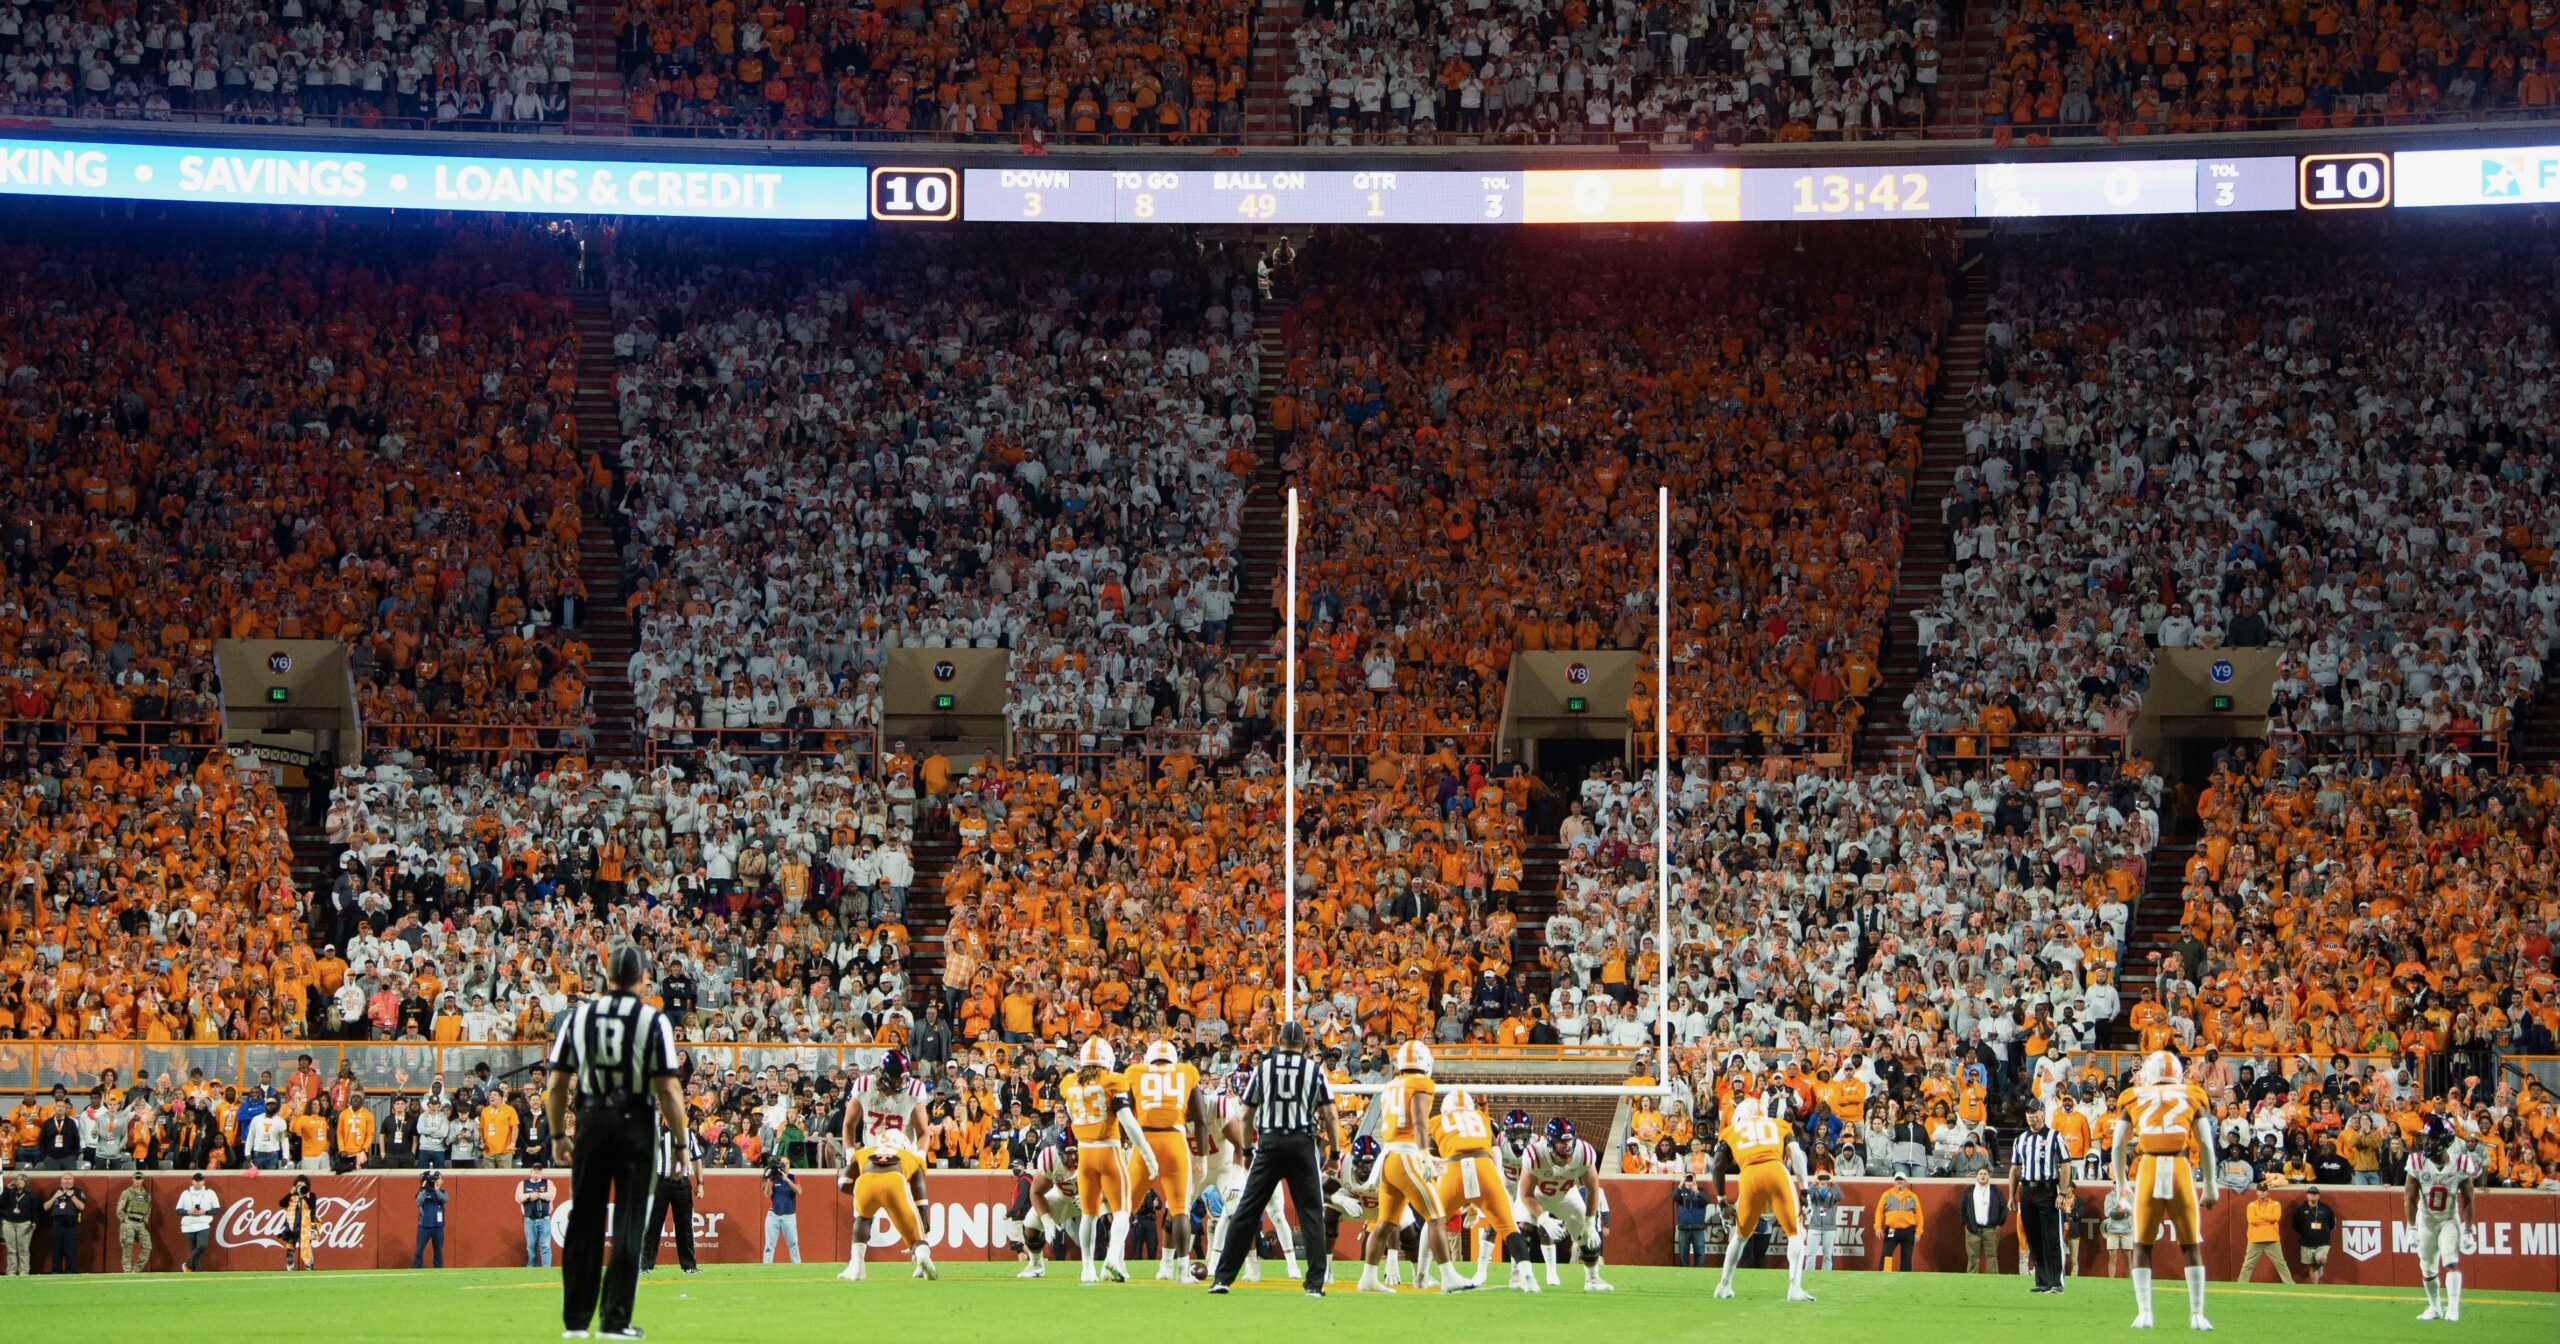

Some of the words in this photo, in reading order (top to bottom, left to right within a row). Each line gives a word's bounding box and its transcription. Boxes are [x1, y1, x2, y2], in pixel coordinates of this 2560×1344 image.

[178, 155, 367, 198] SAVINGS
[1001, 171, 1070, 188] DOWN
[1112, 171, 1142, 189] TO
[1145, 171, 1179, 189] GO
[1213, 172, 1268, 190] BALL
[1272, 173, 1305, 190] ON
[1480, 177, 1511, 190] TOL
[2209, 164, 2239, 178] TOL
[2315, 162, 2380, 200] 10
[435, 164, 578, 204] LOANS
[588, 168, 618, 205] &
[628, 170, 782, 209] CREDIT
[886, 176, 947, 212] 10
[1793, 173, 1930, 213] 13:42
[2214, 182, 2235, 207] 3
[1023, 192, 1042, 217] 3
[1135, 193, 1155, 218] 8
[1238, 192, 1277, 218] 49
[1366, 192, 1385, 217] 1
[1484, 195, 1504, 218] 3
[271, 657, 288, 669] Y6
[936, 666, 954, 677] Y7
[1569, 668, 1587, 680] Y8
[2214, 665, 2232, 677] Y9
[595, 1017, 625, 1065] B
[1140, 1072, 1186, 1110] 94
[1275, 1067, 1300, 1099] U
[1066, 1085, 1107, 1125] 33
[2137, 1090, 2188, 1134] 22
[1441, 1109, 1488, 1138] 48
[1734, 1119, 1780, 1150] 30
[1539, 1179, 1576, 1196] 64
[2428, 1186, 2448, 1212] 0
